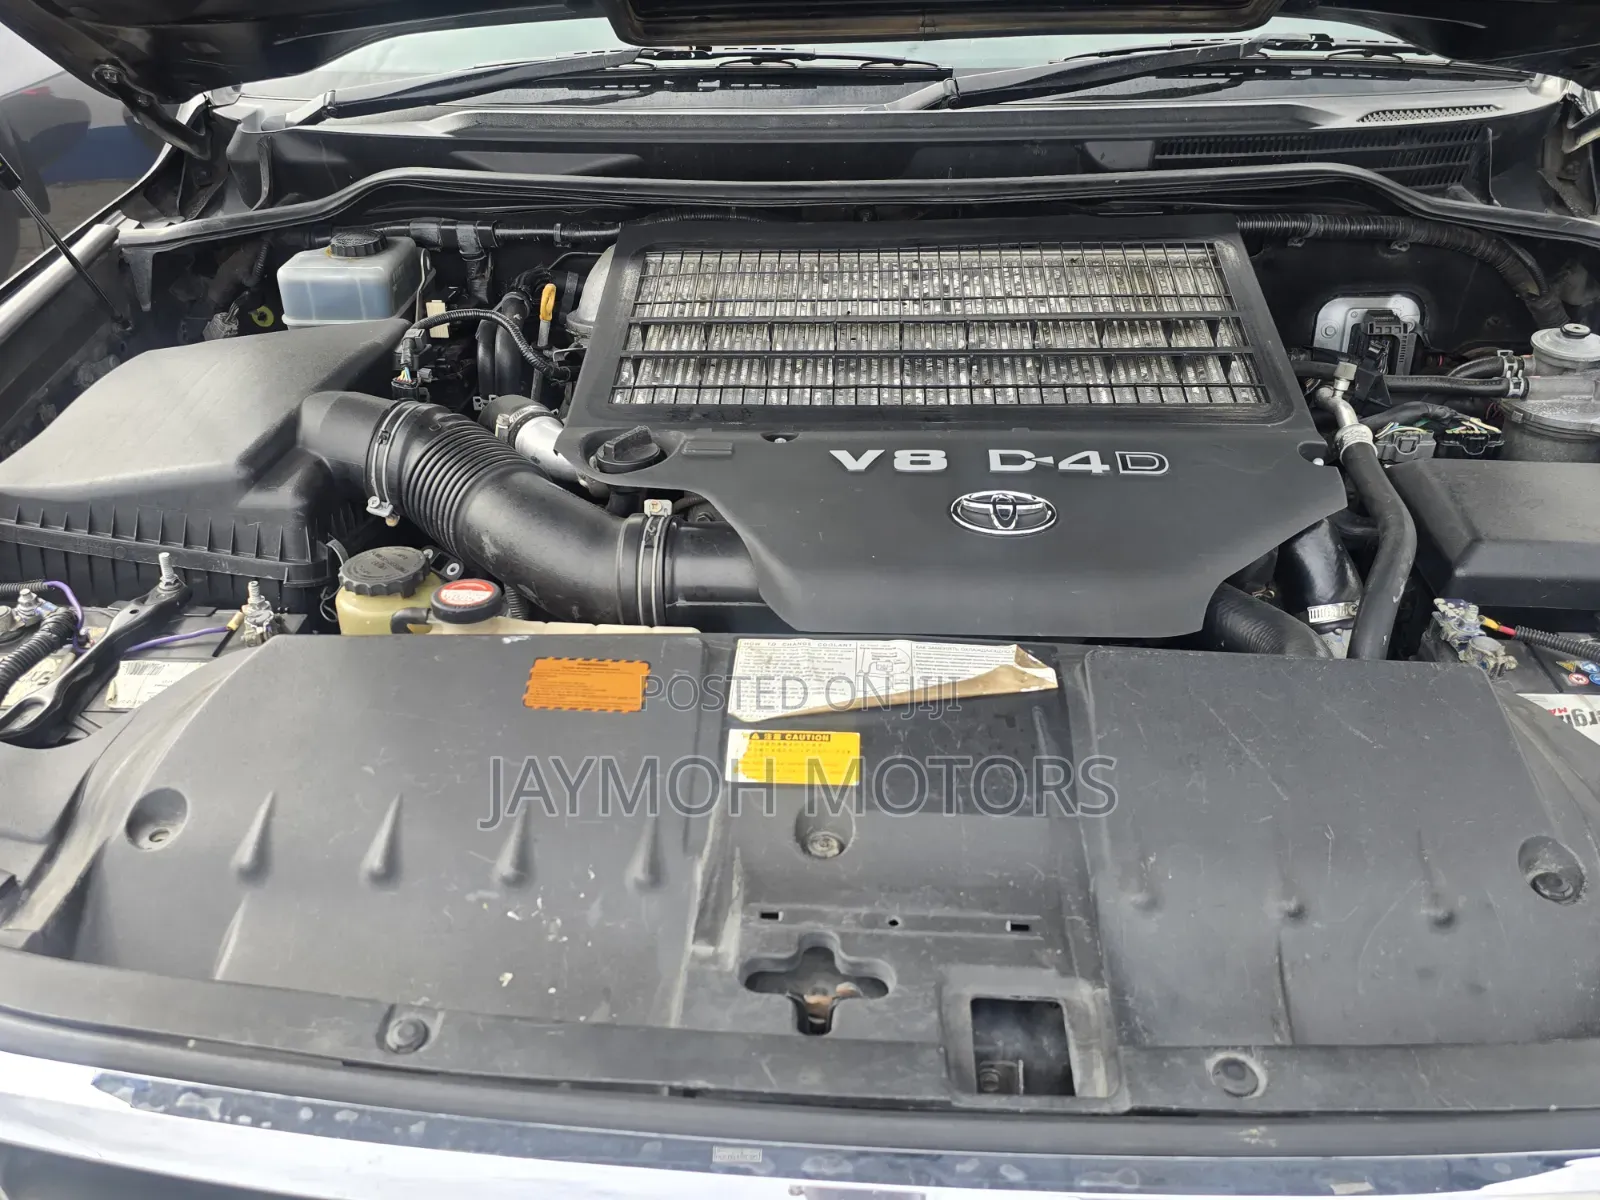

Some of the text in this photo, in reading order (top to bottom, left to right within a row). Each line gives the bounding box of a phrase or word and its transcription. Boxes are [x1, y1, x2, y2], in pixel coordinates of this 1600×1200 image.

[829, 449, 1170, 475] V8 D-4D
[785, 733, 830, 742] CAUTION
